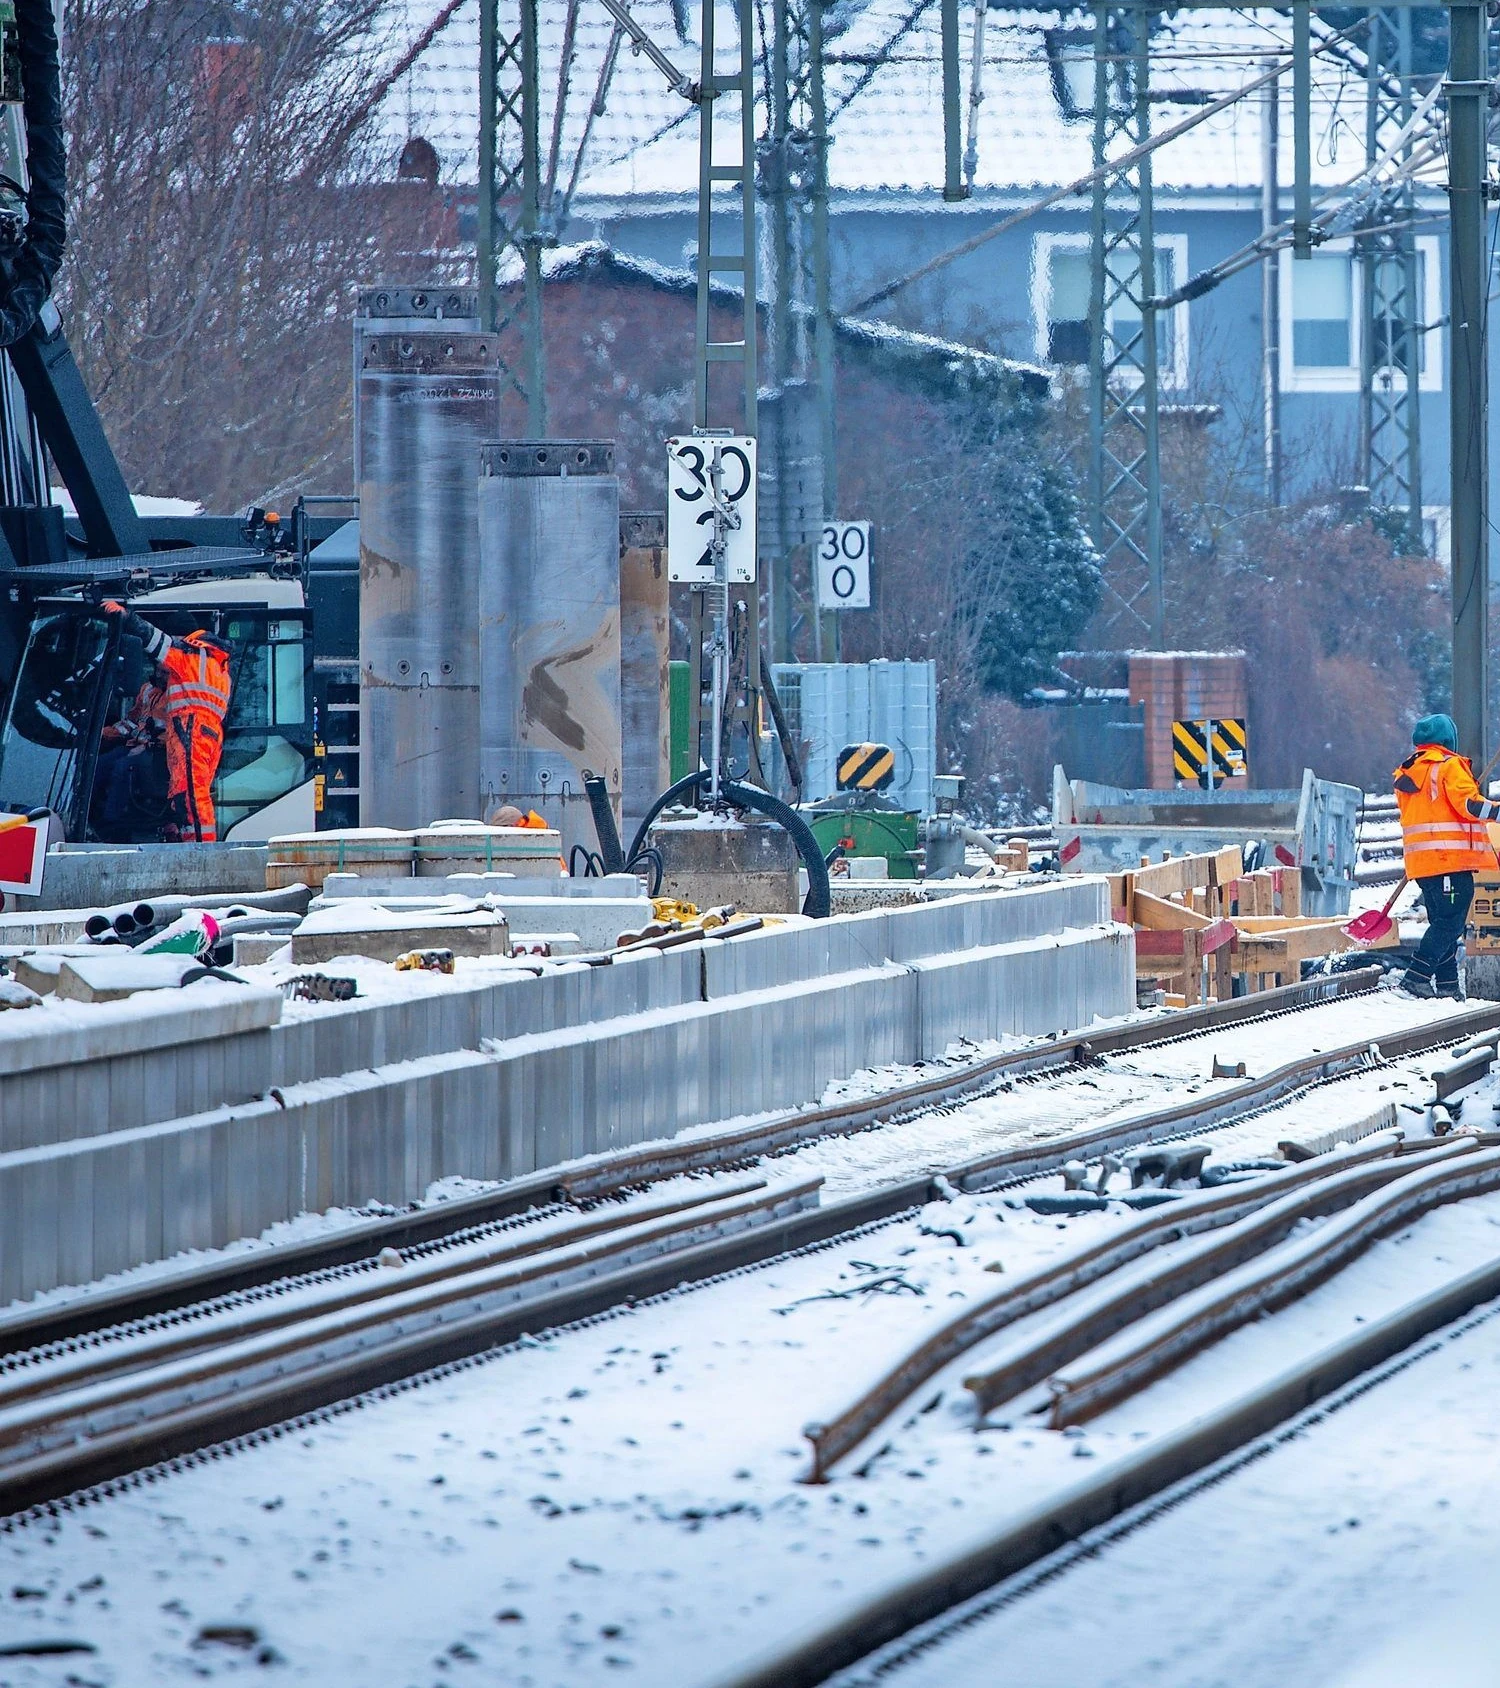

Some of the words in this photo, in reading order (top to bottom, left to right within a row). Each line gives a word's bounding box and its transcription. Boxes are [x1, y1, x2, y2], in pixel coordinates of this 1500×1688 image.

[674, 445, 751, 502] 30
[822, 526, 865, 560] 30
[832, 565, 856, 598] 0
